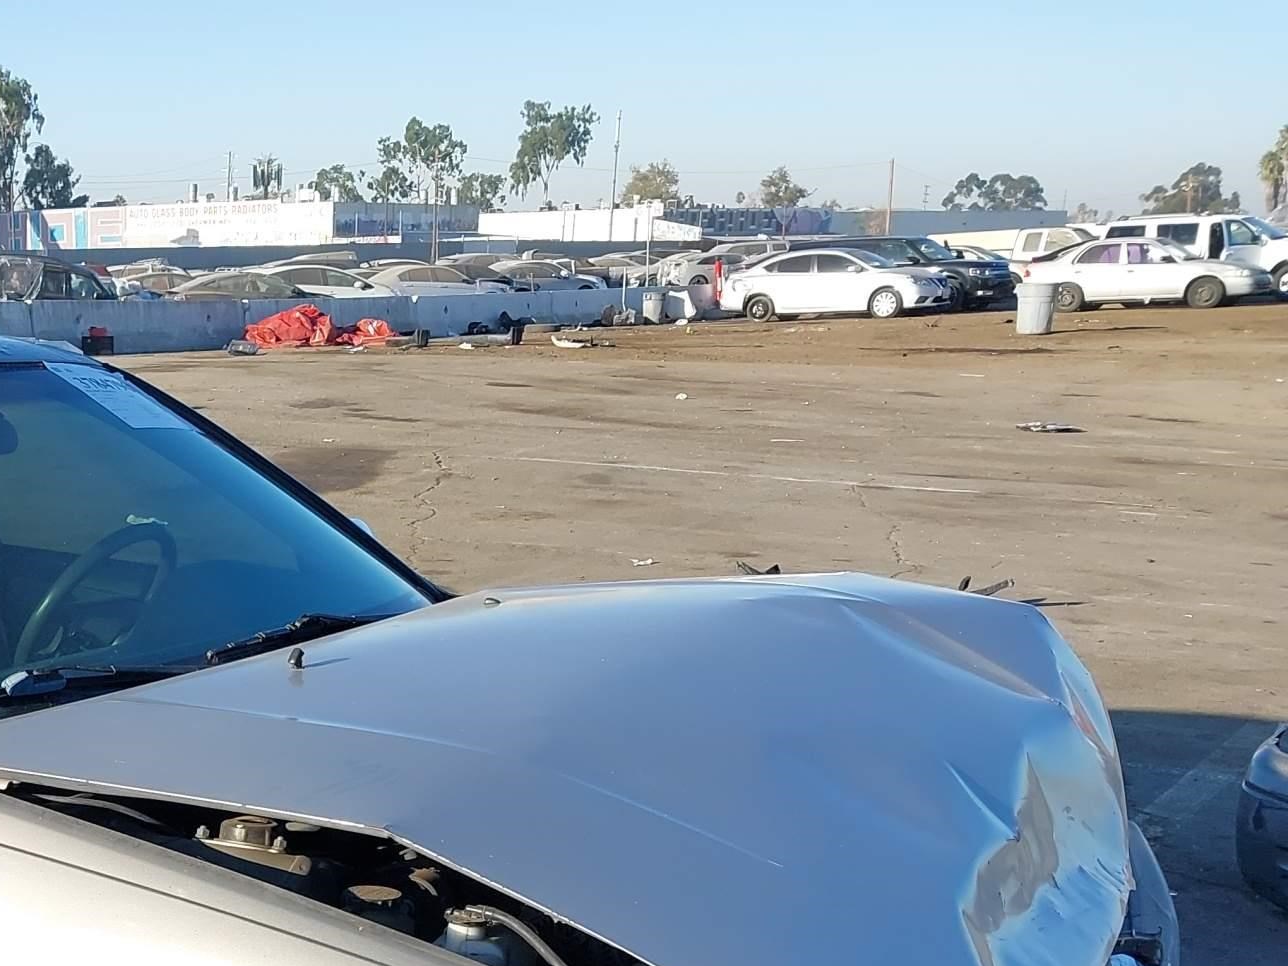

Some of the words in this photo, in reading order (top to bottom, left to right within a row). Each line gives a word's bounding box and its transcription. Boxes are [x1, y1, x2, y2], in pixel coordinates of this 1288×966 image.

[151, 207, 176, 218] GLASS
[179, 207, 199, 217] BODY
[203, 205, 228, 216] PARTS
[231, 203, 279, 215] RADIATORS
